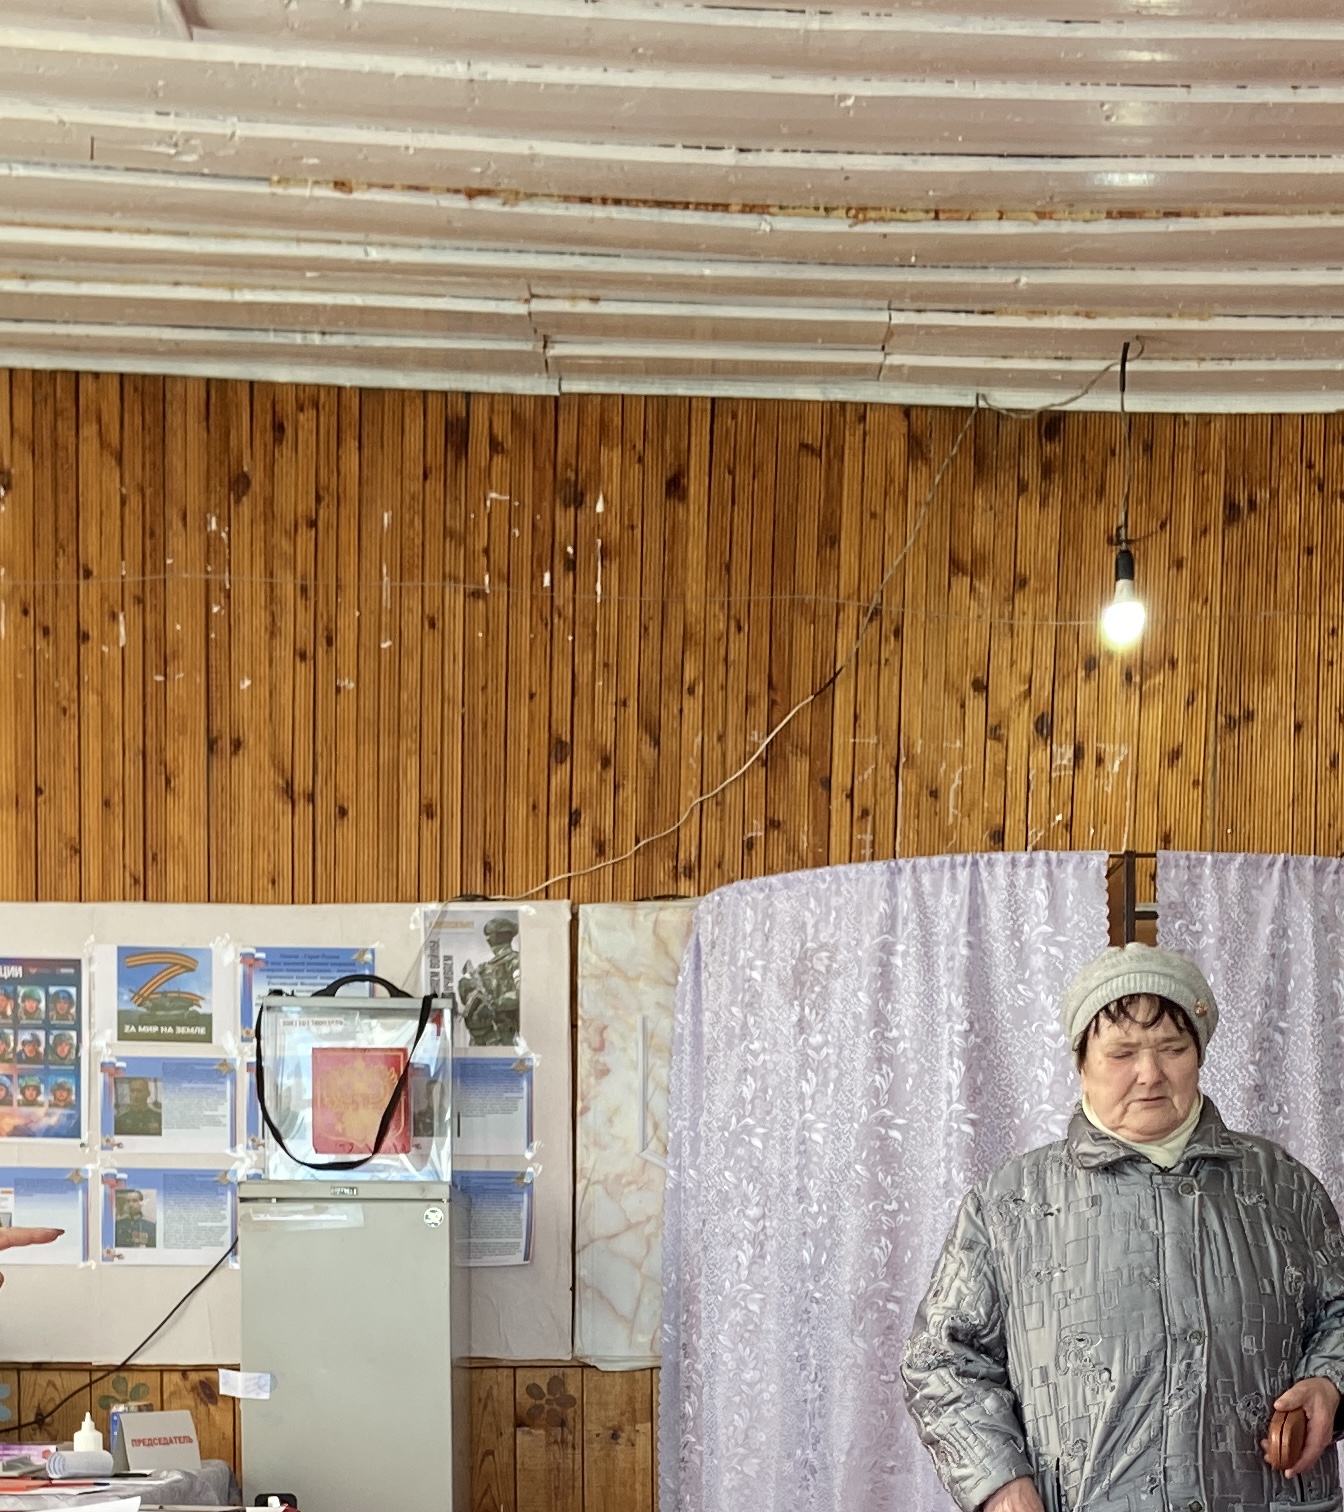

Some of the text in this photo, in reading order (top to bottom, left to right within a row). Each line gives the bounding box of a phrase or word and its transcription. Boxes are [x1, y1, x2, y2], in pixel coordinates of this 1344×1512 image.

[138, 1025, 159, 1034] МИР
[160, 1025, 174, 1035] НА
[175, 1026, 206, 1036] ЗЕМЛЕ
[130, 1434, 194, 1449] ПРЕДСЕДАТЕЛЬ
